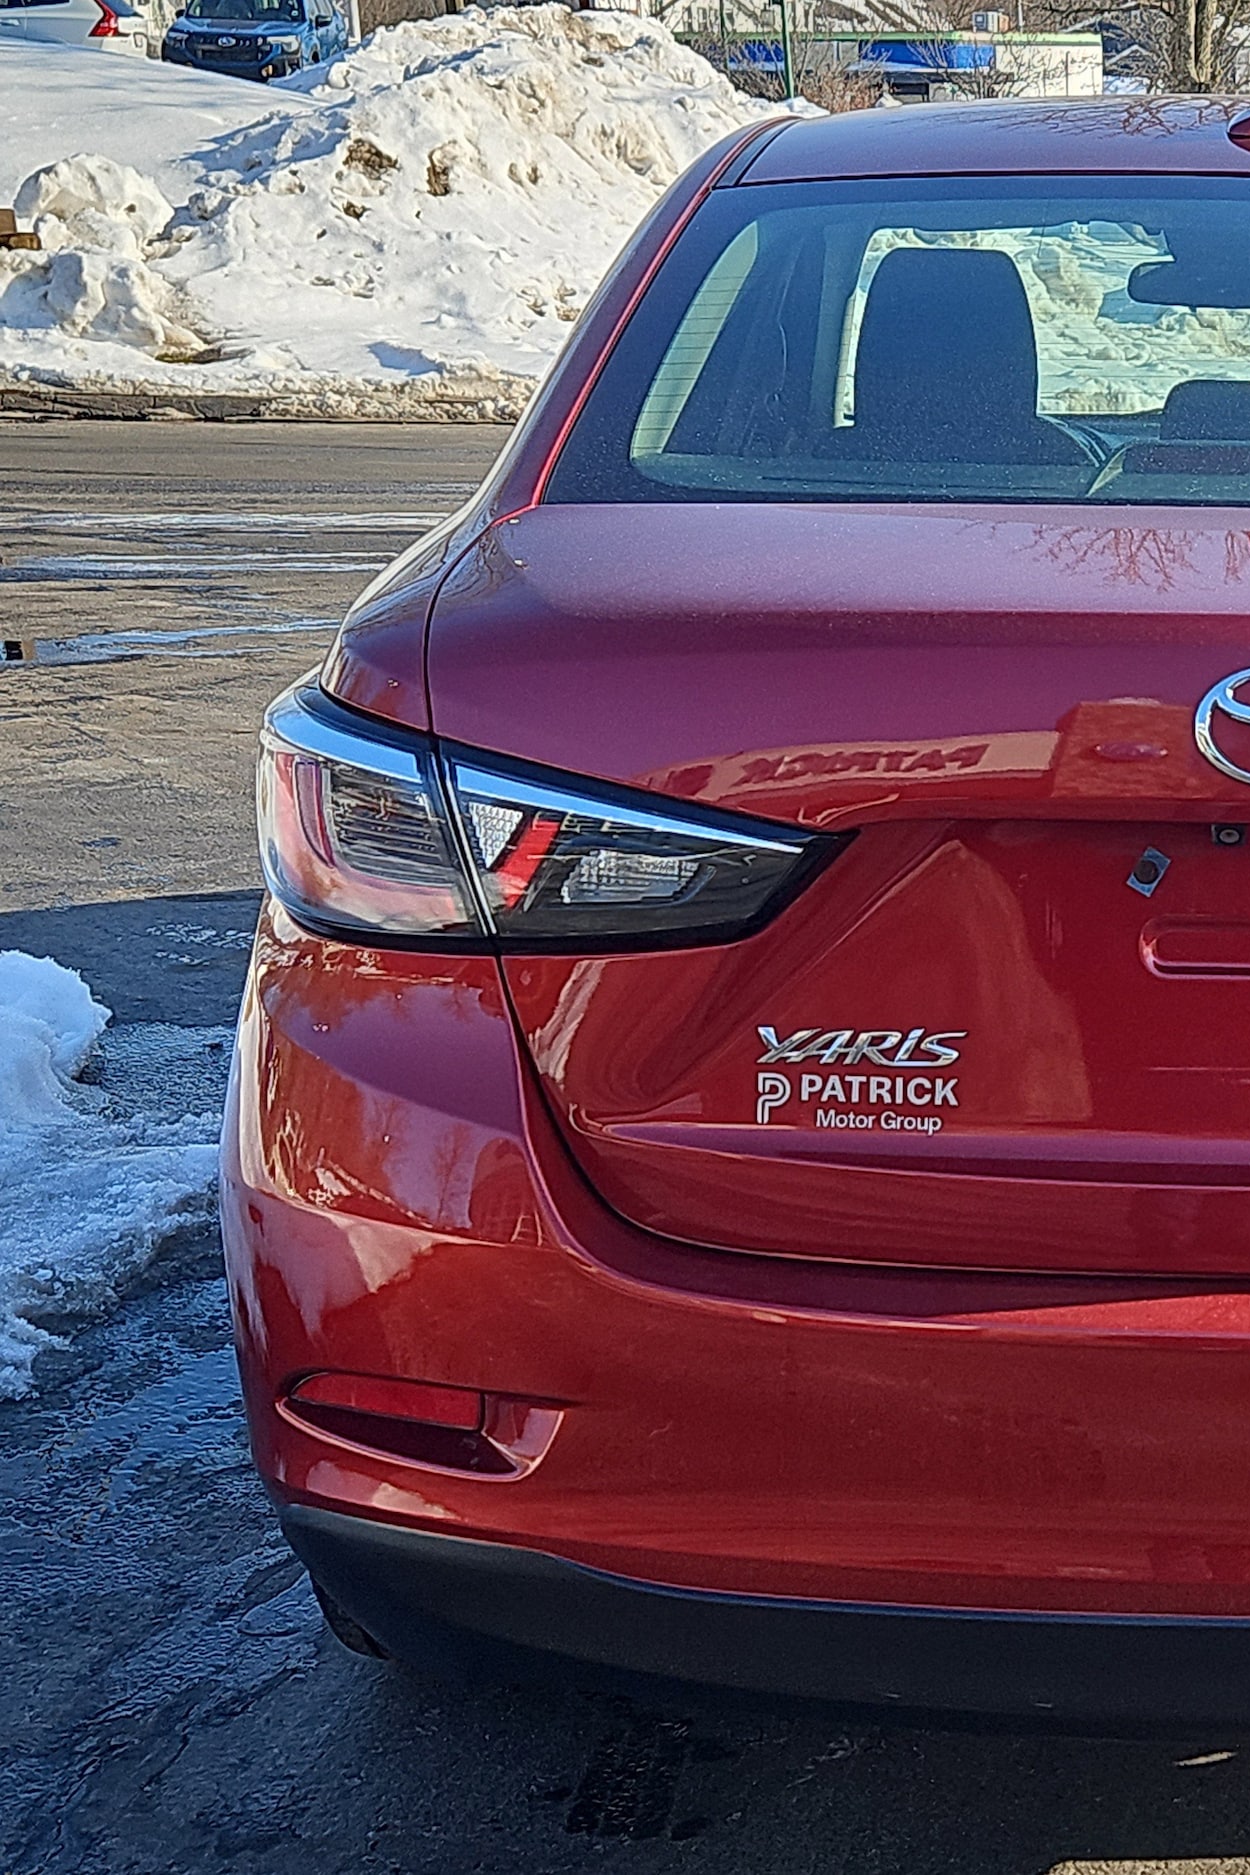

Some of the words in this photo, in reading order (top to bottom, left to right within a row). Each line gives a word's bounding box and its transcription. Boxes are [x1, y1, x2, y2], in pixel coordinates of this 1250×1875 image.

[800, 1073, 959, 1106] PATRICK
[815, 1108, 875, 1129] Motor
[880, 1111, 942, 1136] Group
